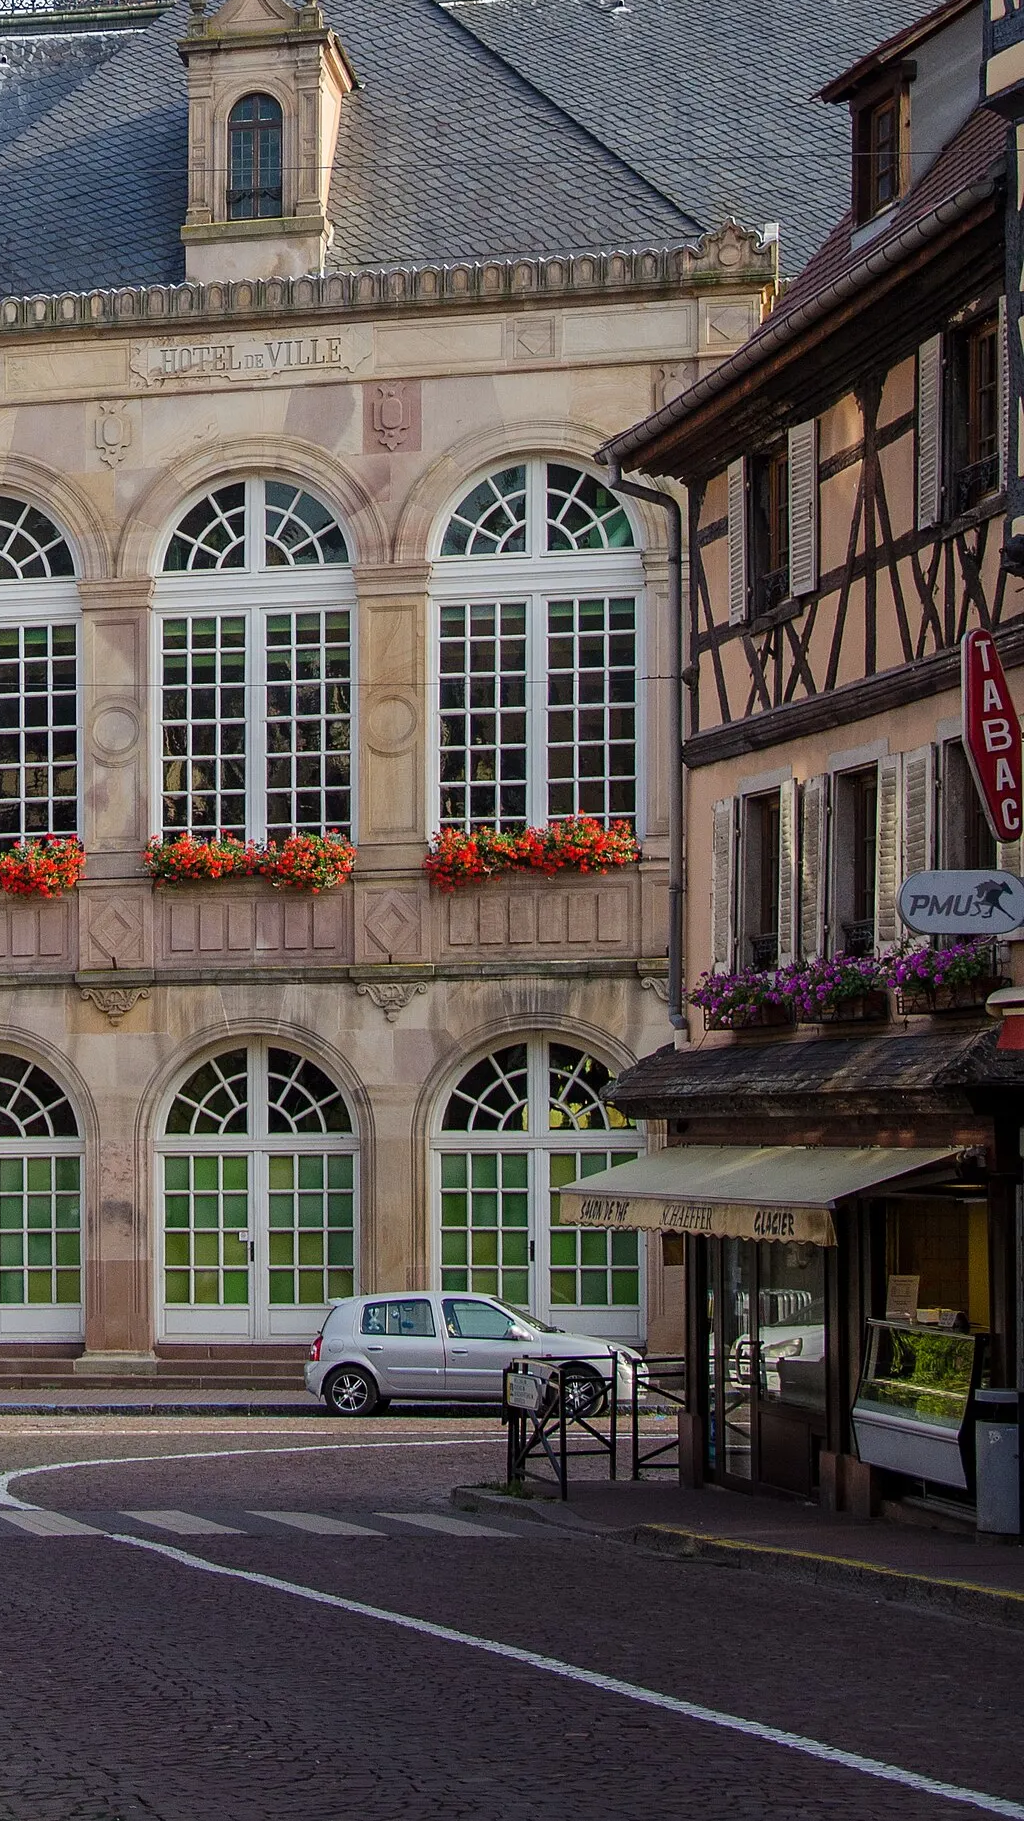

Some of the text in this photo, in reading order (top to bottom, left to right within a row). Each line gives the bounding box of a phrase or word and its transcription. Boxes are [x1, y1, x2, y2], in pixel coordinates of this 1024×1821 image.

[160, 338, 342, 374] HOTEL DE VILLE
[975, 640, 1020, 831] TABAC
[909, 894, 974, 917] PMU
[580, 1199, 603, 1220] SALON
[604, 1200, 615, 1221] DE
[659, 1205, 713, 1230] SCHAEFFER
[754, 1210, 795, 1236] GLACIER
